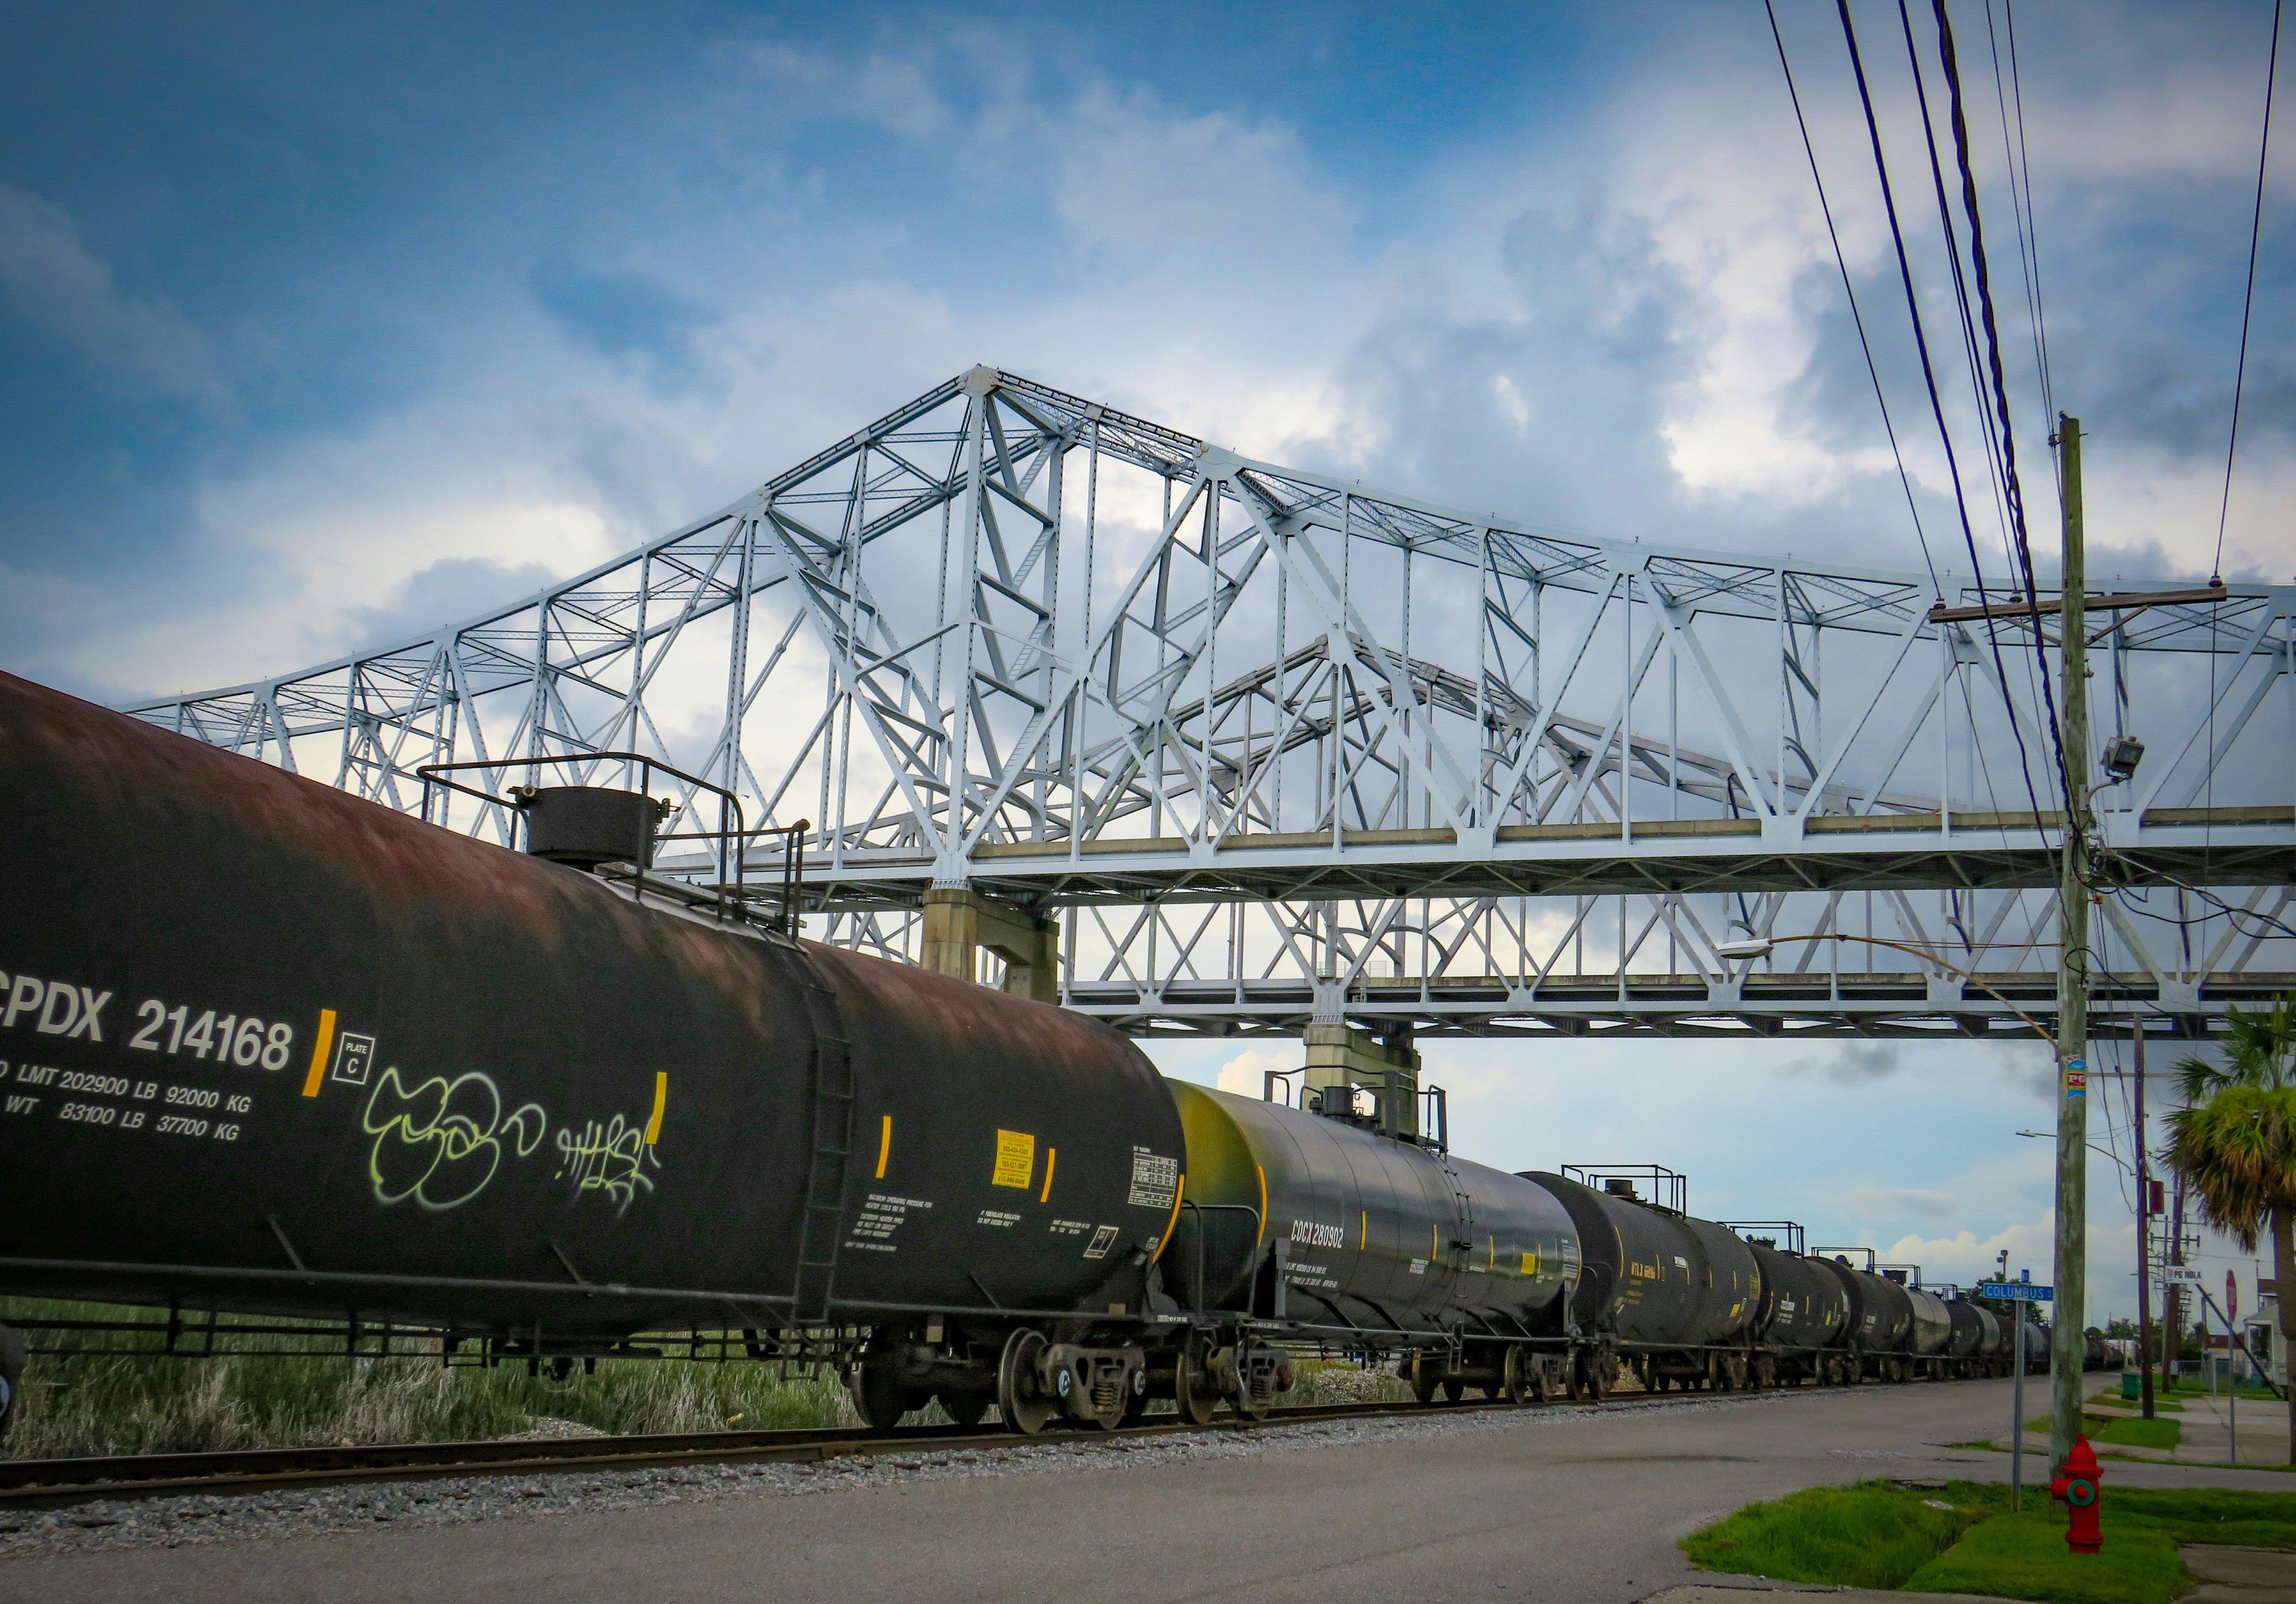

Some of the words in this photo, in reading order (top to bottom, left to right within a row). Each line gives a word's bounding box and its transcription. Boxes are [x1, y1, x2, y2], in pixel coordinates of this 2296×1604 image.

[129, 999, 292, 1071] 214168
[346, 1042, 368, 1054] PLATE
[348, 1058, 359, 1073] C
[16, 1064, 59, 1085] LMT
[58, 1071, 129, 1096] 202900
[133, 1081, 158, 1099] LB
[166, 1086, 219, 1108] 92000
[226, 1095, 252, 1112] KG
[5, 1095, 40, 1114] WT
[60, 1103, 116, 1124] 83100
[120, 1111, 145, 1128] LB
[156, 1116, 208, 1136] 37700
[213, 1123, 240, 1141] KG
[886, 1196, 907, 1205] OPERATING
[906, 1199, 924, 1208] PRESSURE
[1291, 1220, 1314, 1244] COCX
[1312, 1224, 1343, 1248] 280902
[2174, 1270, 2183, 1279] PG
[2184, 1271, 2201, 1279] NOLA
[1986, 1286, 2044, 1299] COLUMBUS
